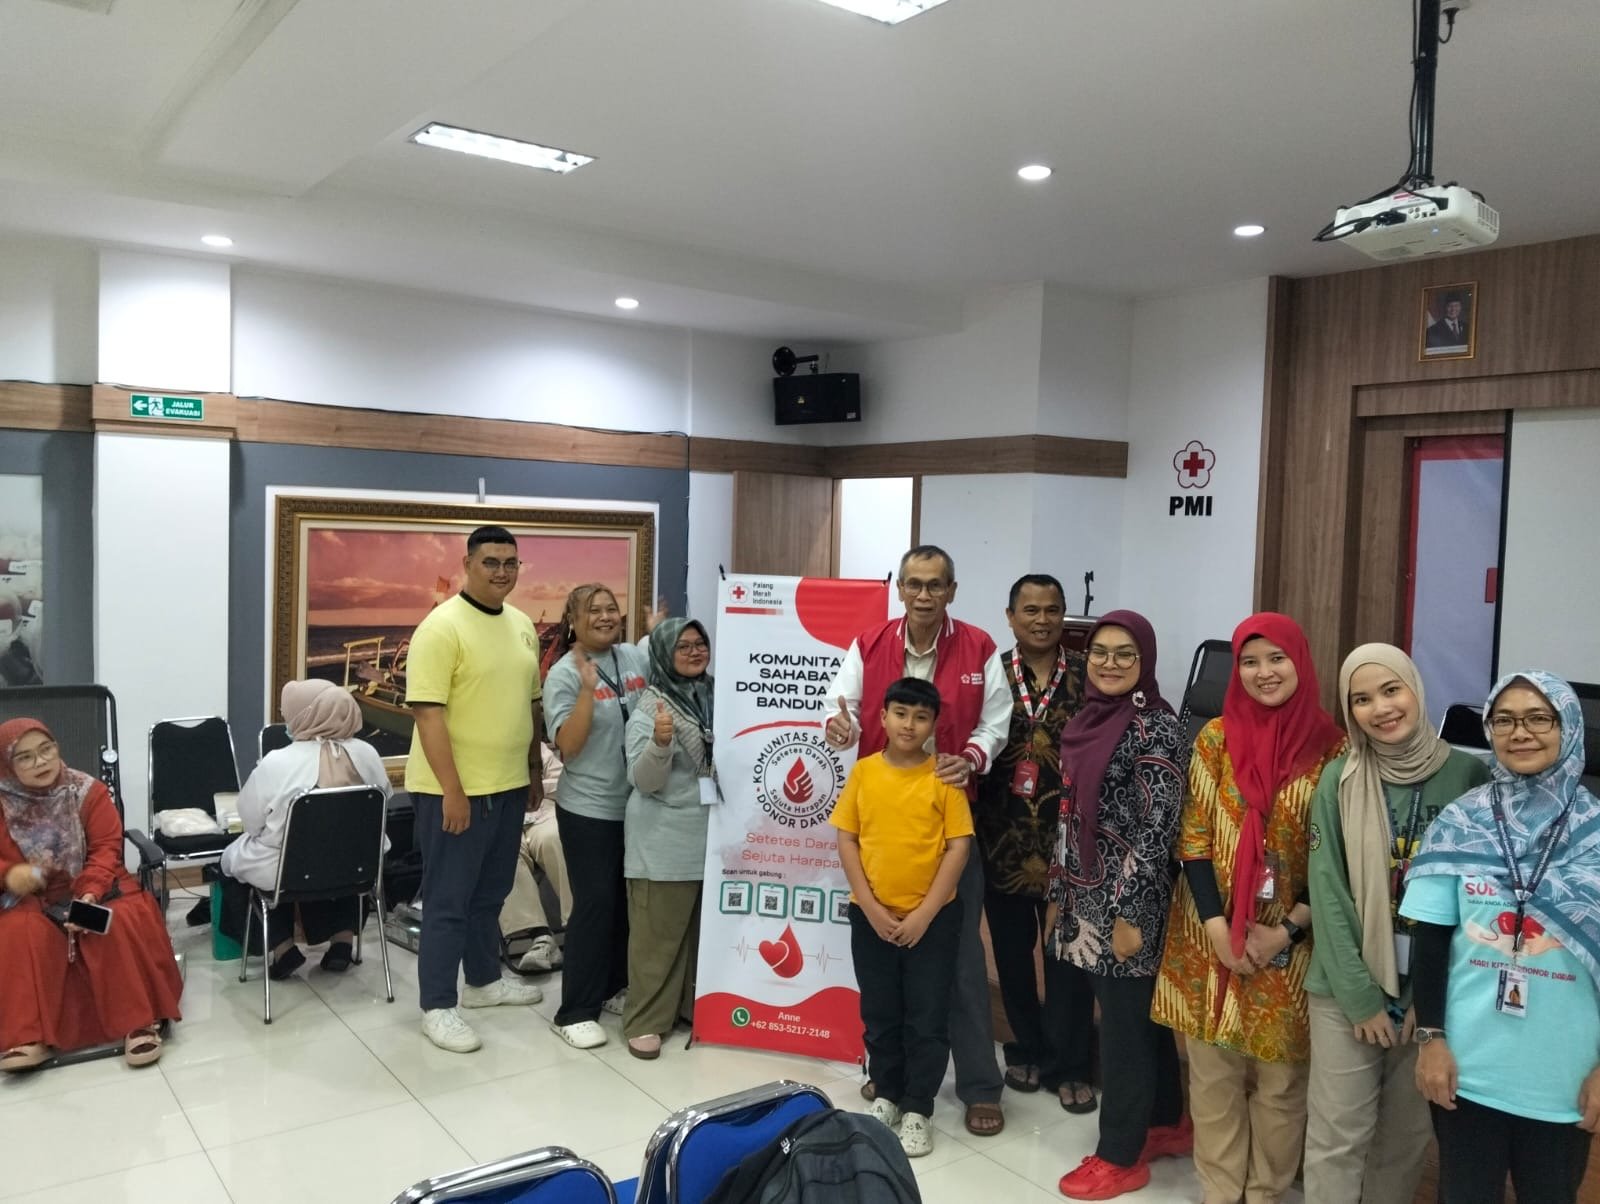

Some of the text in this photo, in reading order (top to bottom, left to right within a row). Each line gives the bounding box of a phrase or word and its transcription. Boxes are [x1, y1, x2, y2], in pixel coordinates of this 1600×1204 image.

[171, 401, 194, 409] JALUR
[1169, 496, 1213, 516] PMI
[753, 582, 774, 590] Palang
[749, 653, 844, 668] KOMUNITA
[736, 681, 798, 695] DONOR
[753, 732, 808, 783] KOMUNITAS
[805, 748, 827, 770] Darah
[770, 789, 827, 813] Sejuta Harapan
[757, 794, 796, 828] DONOR
[746, 832, 838, 850] Setetes Dara
[741, 849, 843, 869] Sejuta Harapa
[759, 870, 782, 879] gabung
[1470, 959, 1489, 968] MARI
[778, 1012, 801, 1022] Anne
[751, 1020, 830, 1039] +62 853-5217-2148
